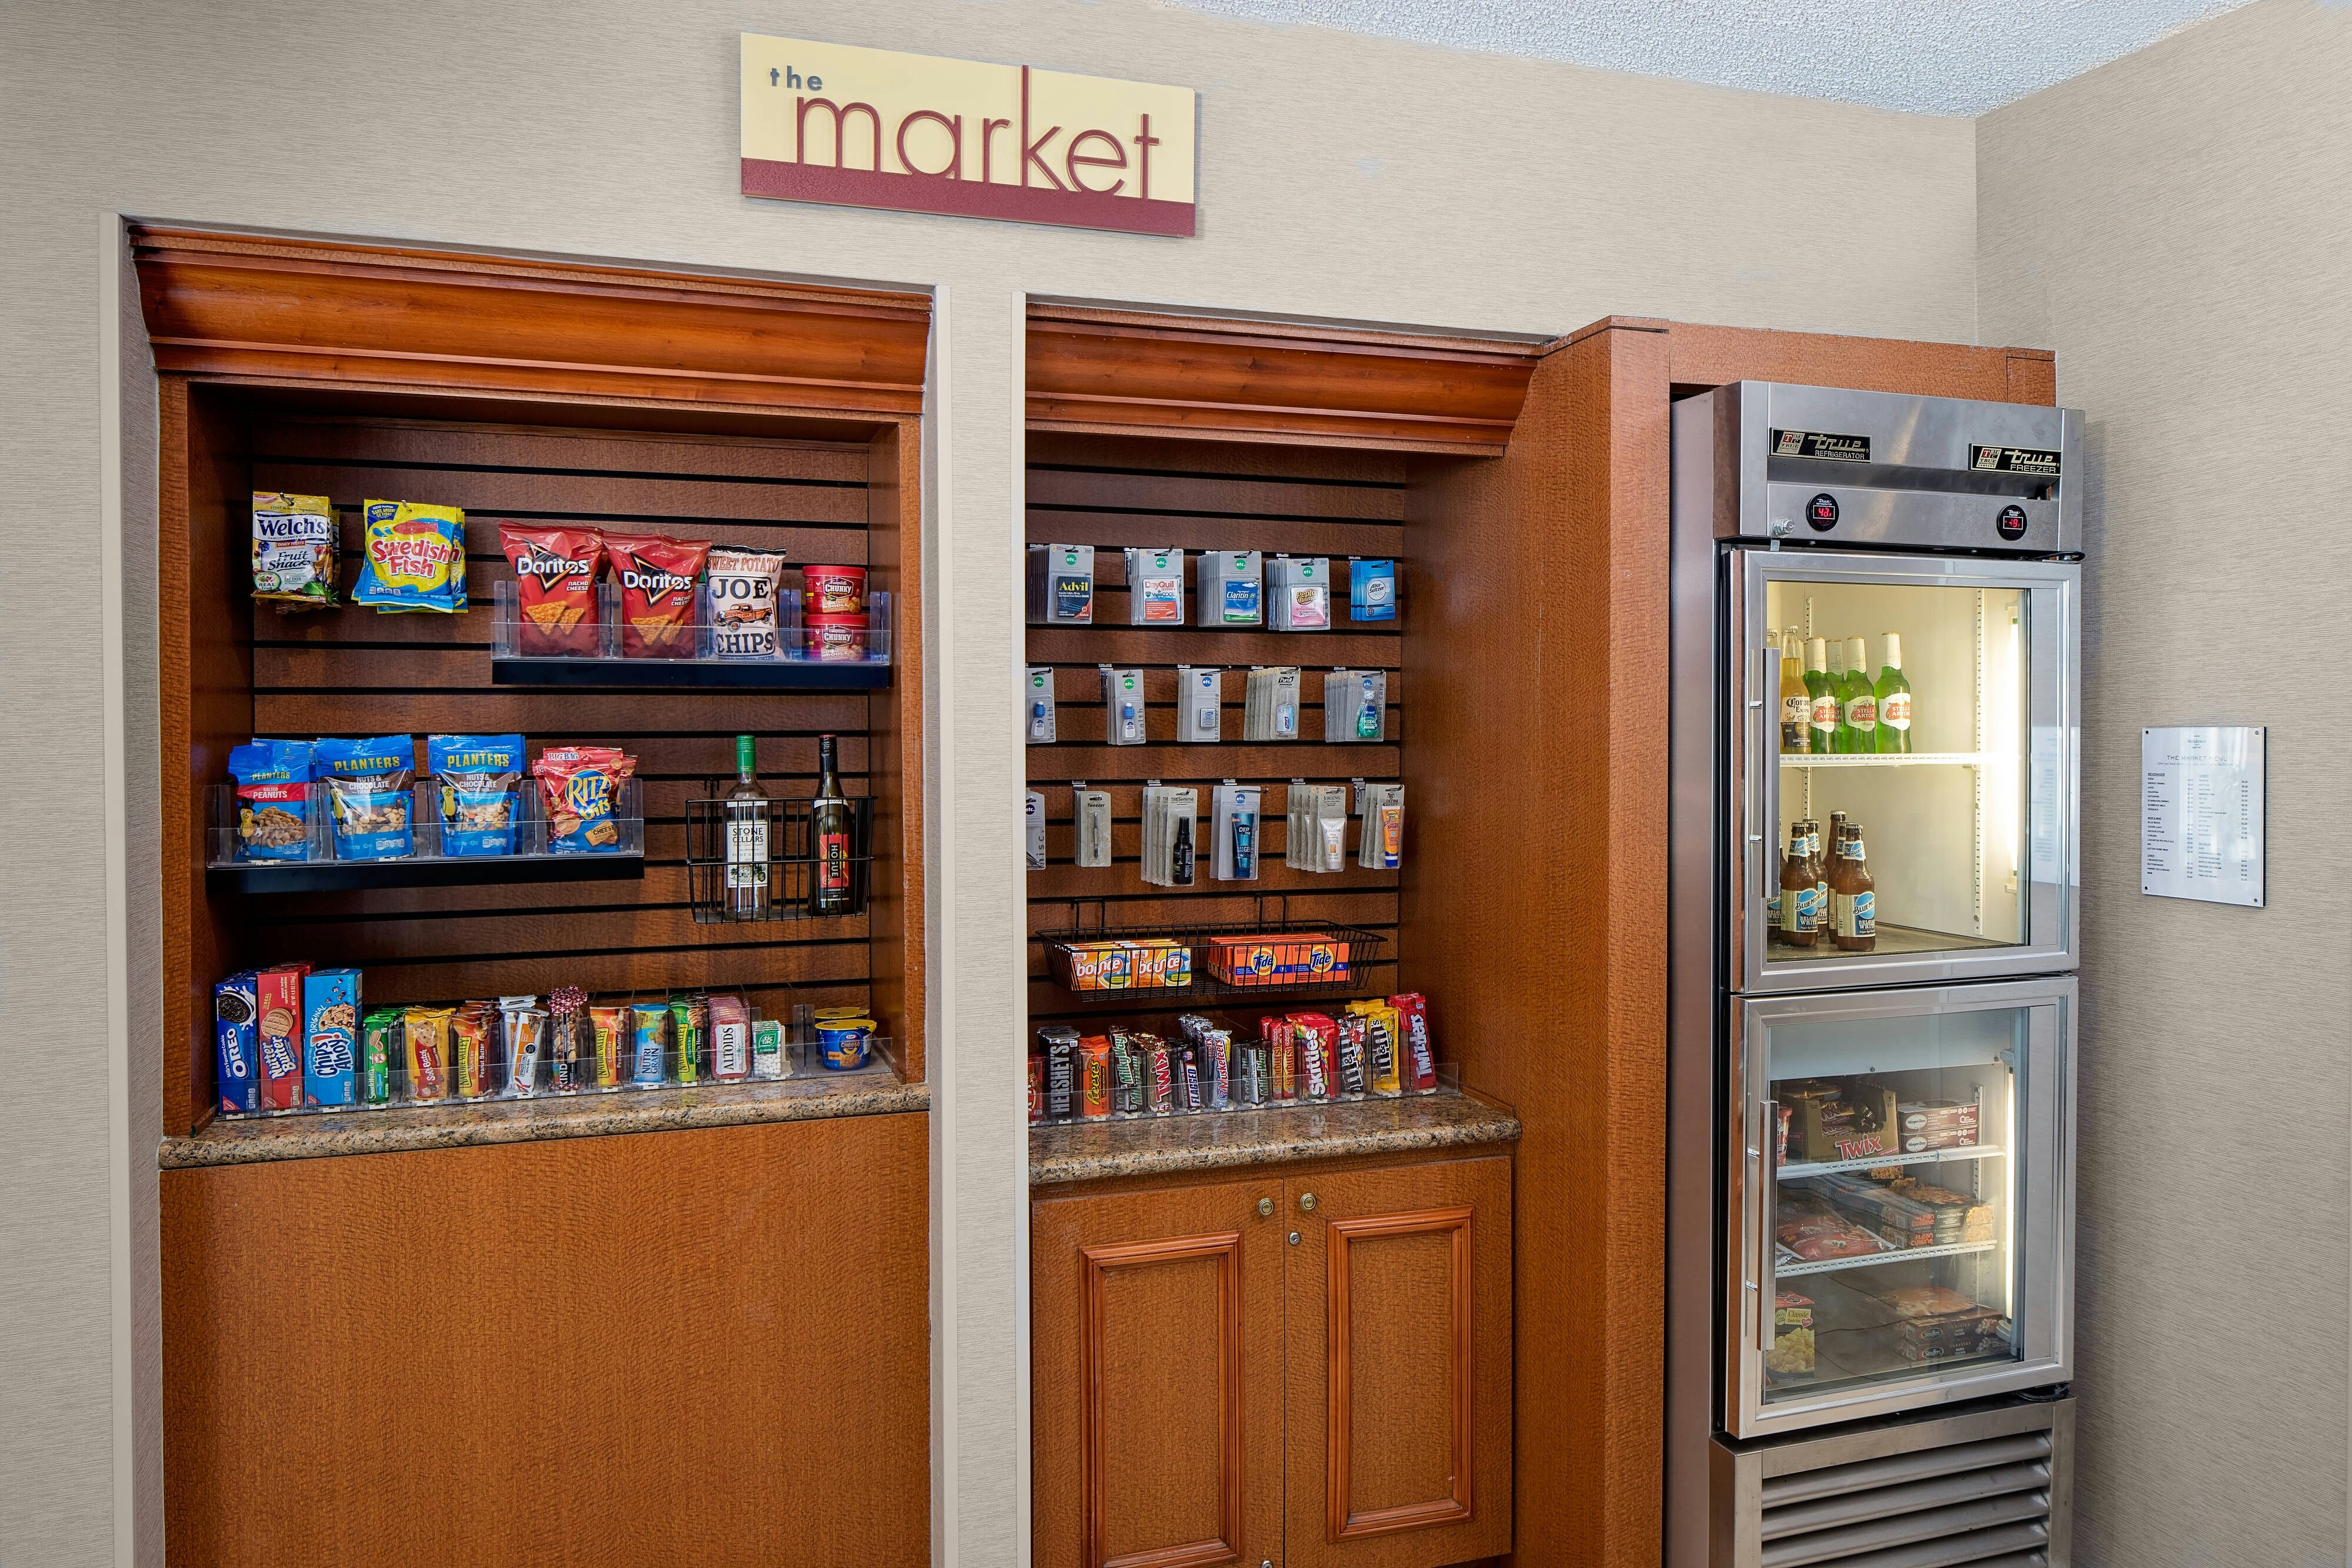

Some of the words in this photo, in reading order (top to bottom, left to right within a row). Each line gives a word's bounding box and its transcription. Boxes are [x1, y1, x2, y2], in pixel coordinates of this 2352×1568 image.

[770, 65, 823, 92] the
[797, 64, 1160, 200] market
[1815, 450, 1865, 460] REFRIGERATOR
[2010, 464, 2056, 473] FREEZER
[257, 517, 326, 536] Welch's
[277, 551, 309, 561] Fruit
[371, 539, 451, 563] Swedish
[388, 555, 435, 577] Fish
[516, 557, 589, 574] Doritos
[706, 556, 739, 571] SWEET
[740, 557, 780, 574] POTATO
[623, 571, 693, 589] Doritos
[711, 579, 769, 599] JOE
[824, 584, 852, 593] CHUNKY
[1058, 581, 1088, 591] Advil
[1144, 580, 1174, 590] DayQuil
[716, 631, 774, 654] CHIPS
[824, 632, 851, 641] CHUNKY
[1786, 697, 1810, 709] Coron
[334, 756, 400, 772] PLANTERS
[447, 753, 509, 768] PLANTERS
[252, 771, 290, 781] PLANTERS
[349, 780, 390, 790] CHOCOLATE
[459, 780, 497, 788] CHOCOLATE
[253, 791, 288, 799] PEANUTS
[567, 775, 612, 810] RITZ
[579, 800, 612, 820] bits
[593, 824, 615, 835] CHEESE
[733, 827, 763, 835] STONE
[1795, 901, 1810, 911] BLUE
[1853, 905, 1869, 914] BLUE
[1075, 958, 1122, 977] bounce
[1138, 957, 1183, 976] bounce
[1252, 954, 1274, 971] Tide
[1311, 952, 1331, 968] Tide
[310, 1004, 327, 1033] ORIGINAL
[596, 1029, 607, 1052] VALLEY
[677, 1025, 687, 1048] VALLEY
[226, 1028, 248, 1078] OREO
[272, 1036, 296, 1072] Butter
[420, 1049, 432, 1068] Batch
[459, 1038, 469, 1061] VALLEY
[723, 1027, 734, 1071] ALTOIDS
[262, 1042, 285, 1079] Nutter
[315, 1042, 336, 1076] Chips
[596, 1052, 605, 1076] NATURE
[642, 1048, 651, 1074] NUTRI
[651, 1048, 659, 1074] GRAIN
[677, 1048, 686, 1072] NATURE
[1215, 1039, 1229, 1089] Musketeers
[1304, 1029, 1326, 1095] Skittles
[459, 1061, 467, 1086] NATURE
[1050, 1045, 1070, 1113] HERSHEY'S
[1085, 1059, 1100, 1105] Reese's
[1187, 1068, 1199, 1104] FLAGGED
